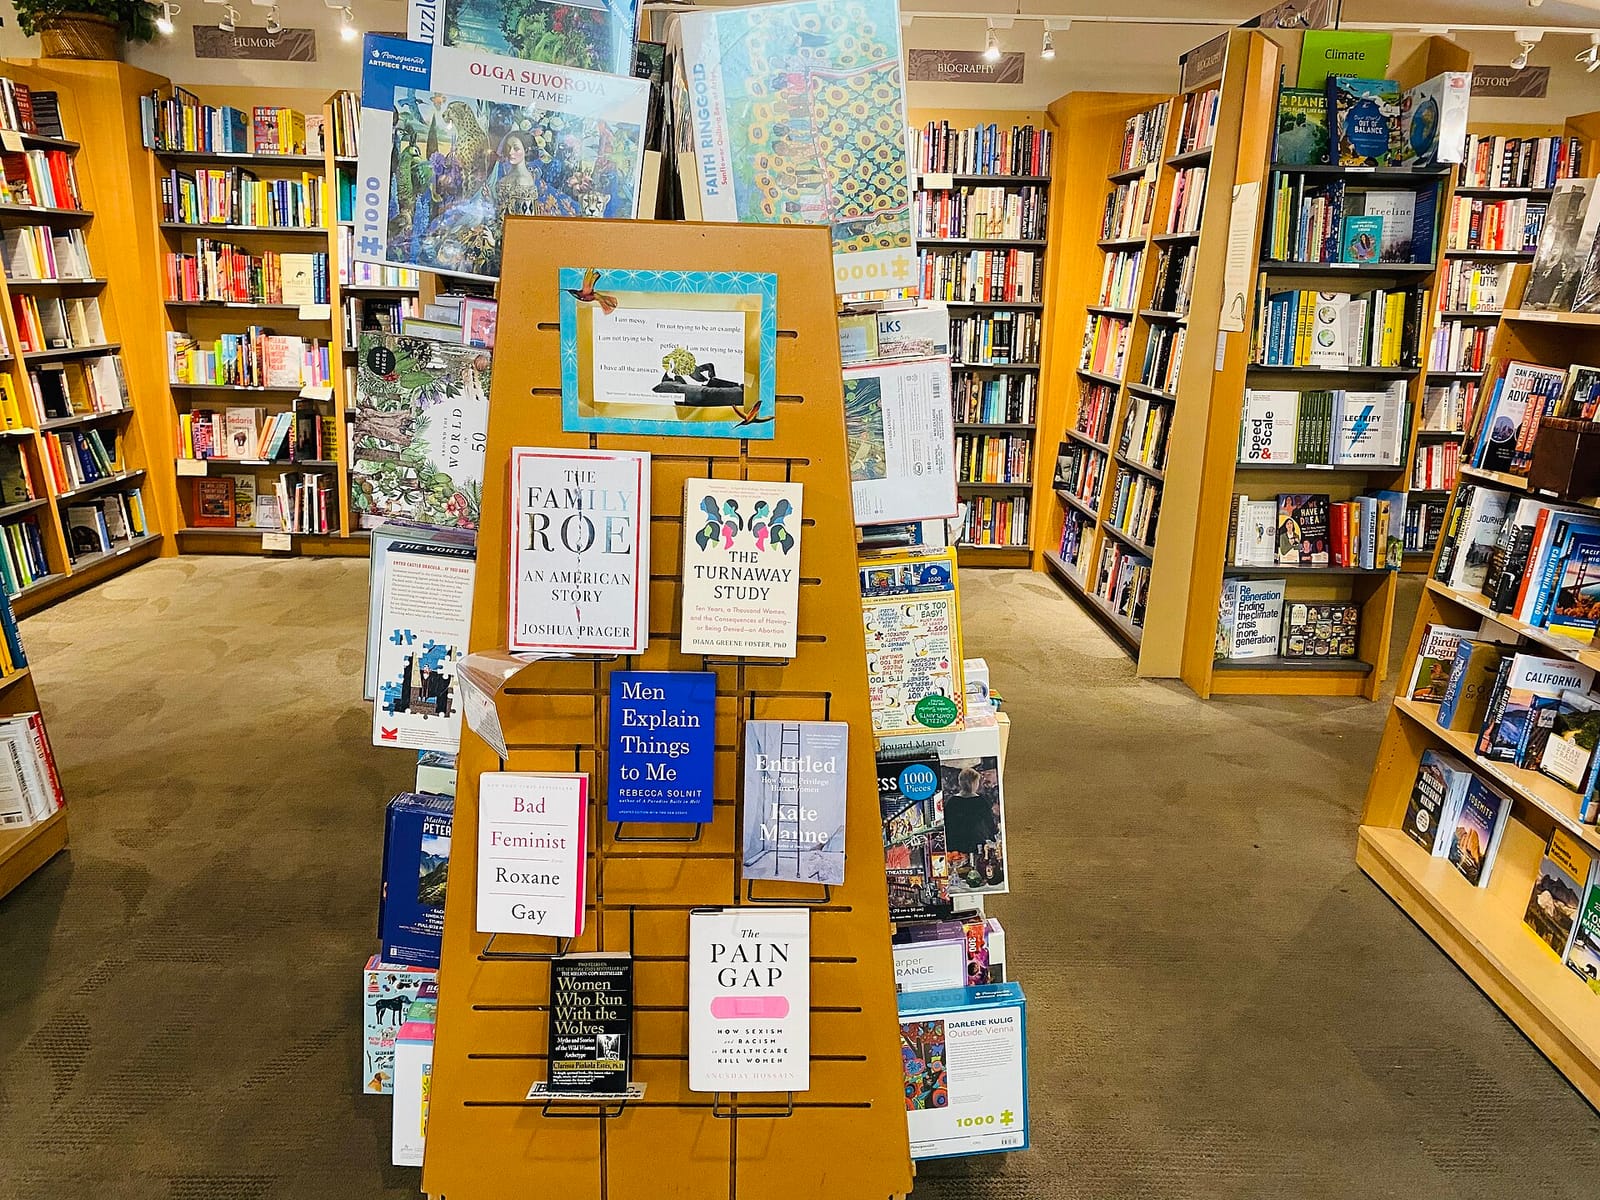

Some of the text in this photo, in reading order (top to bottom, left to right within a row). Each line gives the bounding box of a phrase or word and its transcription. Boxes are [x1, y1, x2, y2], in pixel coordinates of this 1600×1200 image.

[233, 37, 275, 48] HUMOR
[1324, 48, 1365, 60] Climate
[368, 59, 427, 74] ARTPIECE PUZZLE
[937, 63, 995, 74] BIOGRAPHY
[469, 62, 605, 97] OLGA SUVOROVA
[500, 84, 574, 105] THE TAMER
[692, 63, 720, 197] FAITH RINGGOLD
[1354, 125, 1383, 134] BALANCE
[718, 149, 729, 186] Sunflower
[364, 176, 381, 235] 1000
[1370, 208, 1411, 216] Treeline
[676, 324, 694, 332] trying
[880, 320, 901, 333] LKS
[1515, 368, 1526, 377] SAN
[1516, 396, 1535, 449] CALIFORNIA
[1525, 397, 1545, 450] CALIFORNIA
[448, 408, 463, 468] WORLD
[472, 432, 486, 453] 50
[1249, 419, 1262, 459] Speed
[1260, 411, 1274, 460] & Scale
[564, 469, 596, 484] THE
[527, 486, 632, 512] FAMILY
[1301, 508, 1318, 516] HAVE
[1300, 515, 1326, 525] DREAM
[524, 512, 632, 555] ROE
[426, 546, 470, 555] WORLD
[728, 550, 759, 564] THE
[524, 571, 632, 586] AN AMERICAN
[694, 565, 792, 583] TURNAWAY
[1535, 549, 1558, 615] CALIFORNIA HIKING
[551, 589, 603, 603] STORY
[714, 585, 770, 601] STUDY
[1240, 585, 1251, 594] Re
[1240, 592, 1281, 602] generation
[695, 605, 786, 616] Ten Years, Thousand Women,
[921, 610, 943, 618] EASY!
[1238, 602, 1264, 612] Ending
[714, 615, 755, 625] Consequences
[1238, 609, 1278, 621] the climate
[522, 623, 631, 638] JOSHUA PRAGER
[704, 624, 785, 635] Being Abortion
[1237, 620, 1256, 629] crisis
[1236, 629, 1258, 638] in one
[715, 638, 743, 647] GREENE
[744, 640, 772, 648] FOSTER,
[773, 641, 787, 649] PhD
[1236, 635, 1276, 648] generation
[870, 676, 885, 684] TOO
[1525, 672, 1581, 688] CALIFORNIA
[621, 682, 665, 700] Men
[621, 708, 700, 730] Explain
[620, 736, 691, 758] Things
[880, 739, 945, 751] douard Manet
[755, 754, 836, 774] Entitled
[620, 763, 677, 781] to Me
[903, 772, 933, 785] 1000
[761, 776, 829, 787] How Male Privilege
[906, 784, 931, 792] Pieces
[1423, 772, 1443, 795] NORTHERN
[619, 789, 702, 798] REBECCA SOLNIT
[794, 785, 819, 794] Women
[1418, 780, 1441, 806] CALIFORNIA
[513, 797, 546, 814] Bad
[1421, 794, 1435, 812] HIKING
[1469, 793, 1493, 820] YOSEMITE
[771, 803, 818, 822] Kate
[423, 823, 452, 836] PETER
[759, 824, 828, 844] Manne
[491, 831, 567, 850] Feminist
[495, 867, 560, 886] Roxane
[511, 904, 547, 925] Gay
[741, 929, 760, 939] The
[968, 936, 976, 953] 300
[710, 943, 789, 963] PAIN
[896, 957, 923, 967] arper
[557, 977, 611, 991] Women
[717, 967, 782, 988] GAP
[555, 992, 623, 1006] Who Run
[555, 1007, 617, 1020] With the
[555, 1021, 605, 1034] Wolves
[948, 1016, 1014, 1029] DARLENE KULIG
[949, 1025, 1014, 1038] Outside Vienna
[956, 1115, 994, 1128] 1000
